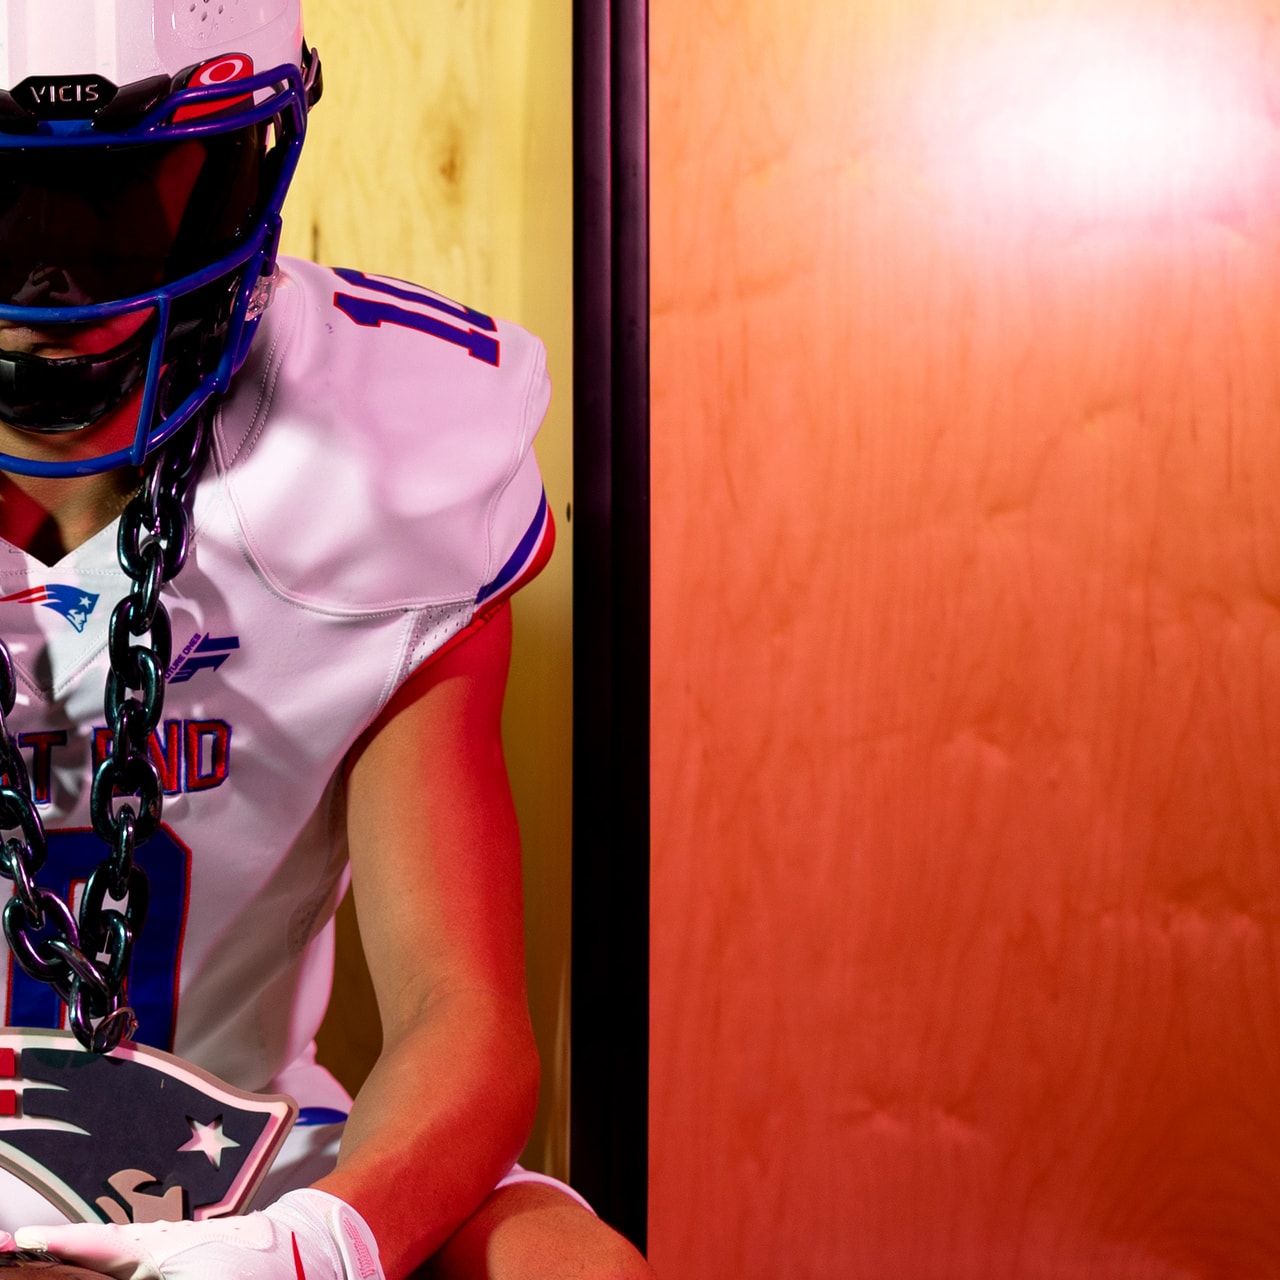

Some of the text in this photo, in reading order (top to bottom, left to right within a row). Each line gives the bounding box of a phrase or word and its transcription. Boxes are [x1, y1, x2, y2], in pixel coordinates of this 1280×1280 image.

[30, 84, 99, 103] VICIS
[164, 632, 202, 680] UTURE ONES
